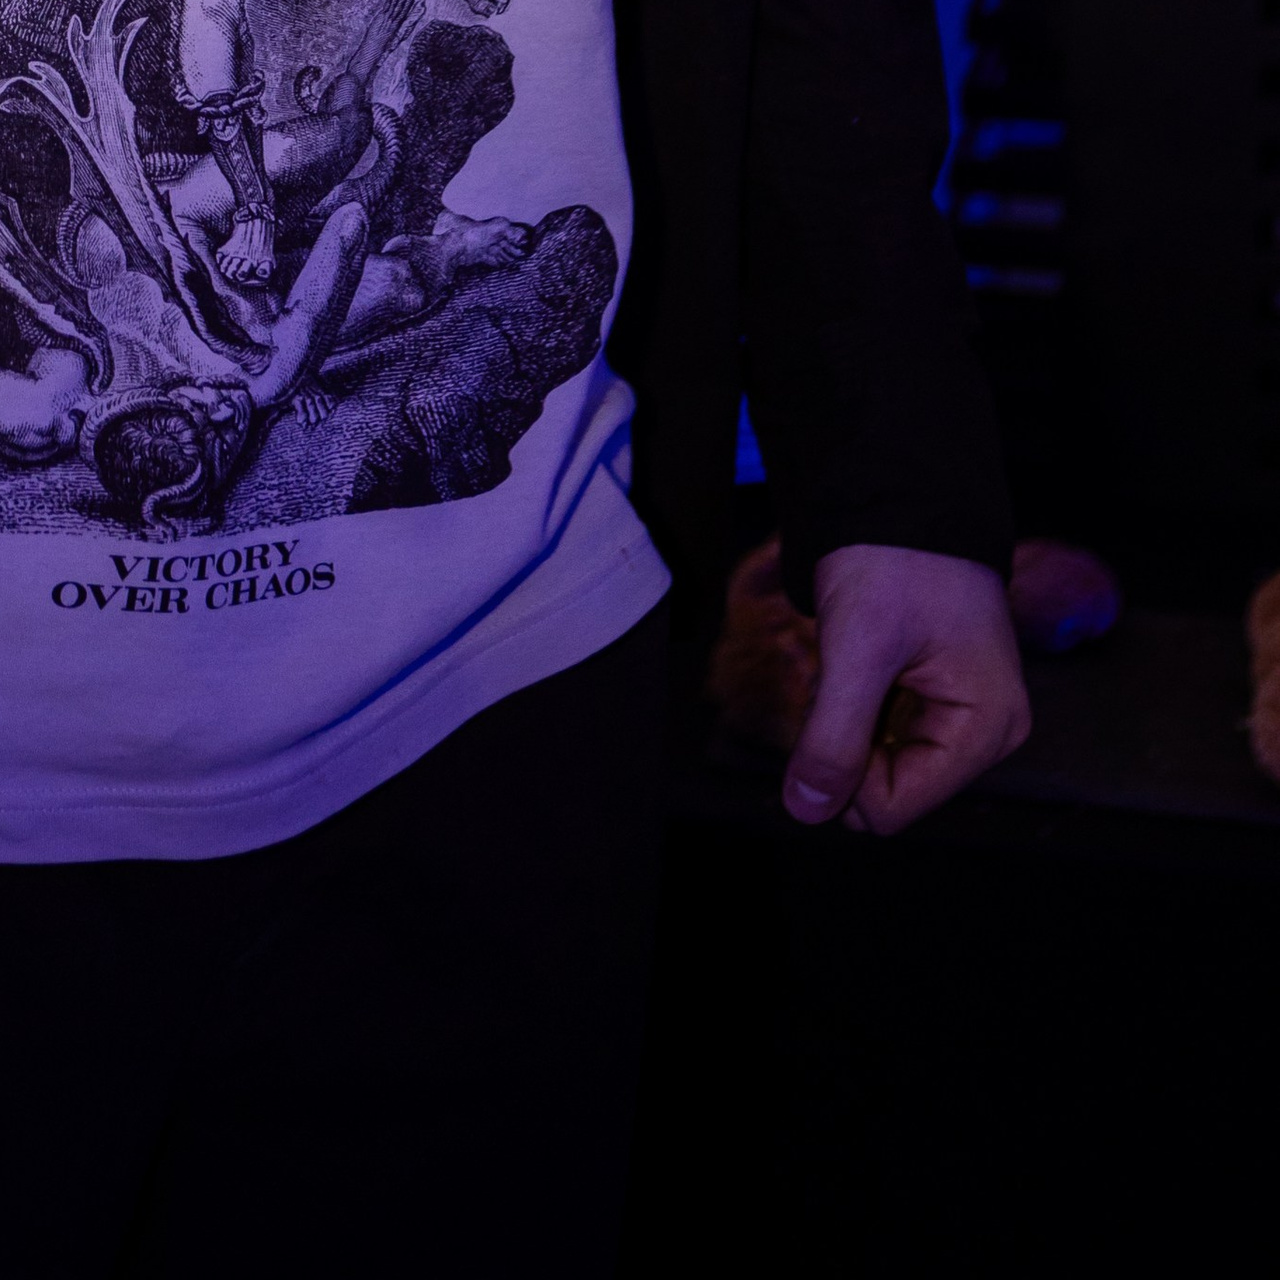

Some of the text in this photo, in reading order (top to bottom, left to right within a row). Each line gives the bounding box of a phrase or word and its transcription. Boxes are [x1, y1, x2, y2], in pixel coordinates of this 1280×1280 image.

[109, 539, 299, 582] VICTORY
[51, 562, 335, 613] OVER CHAOS
